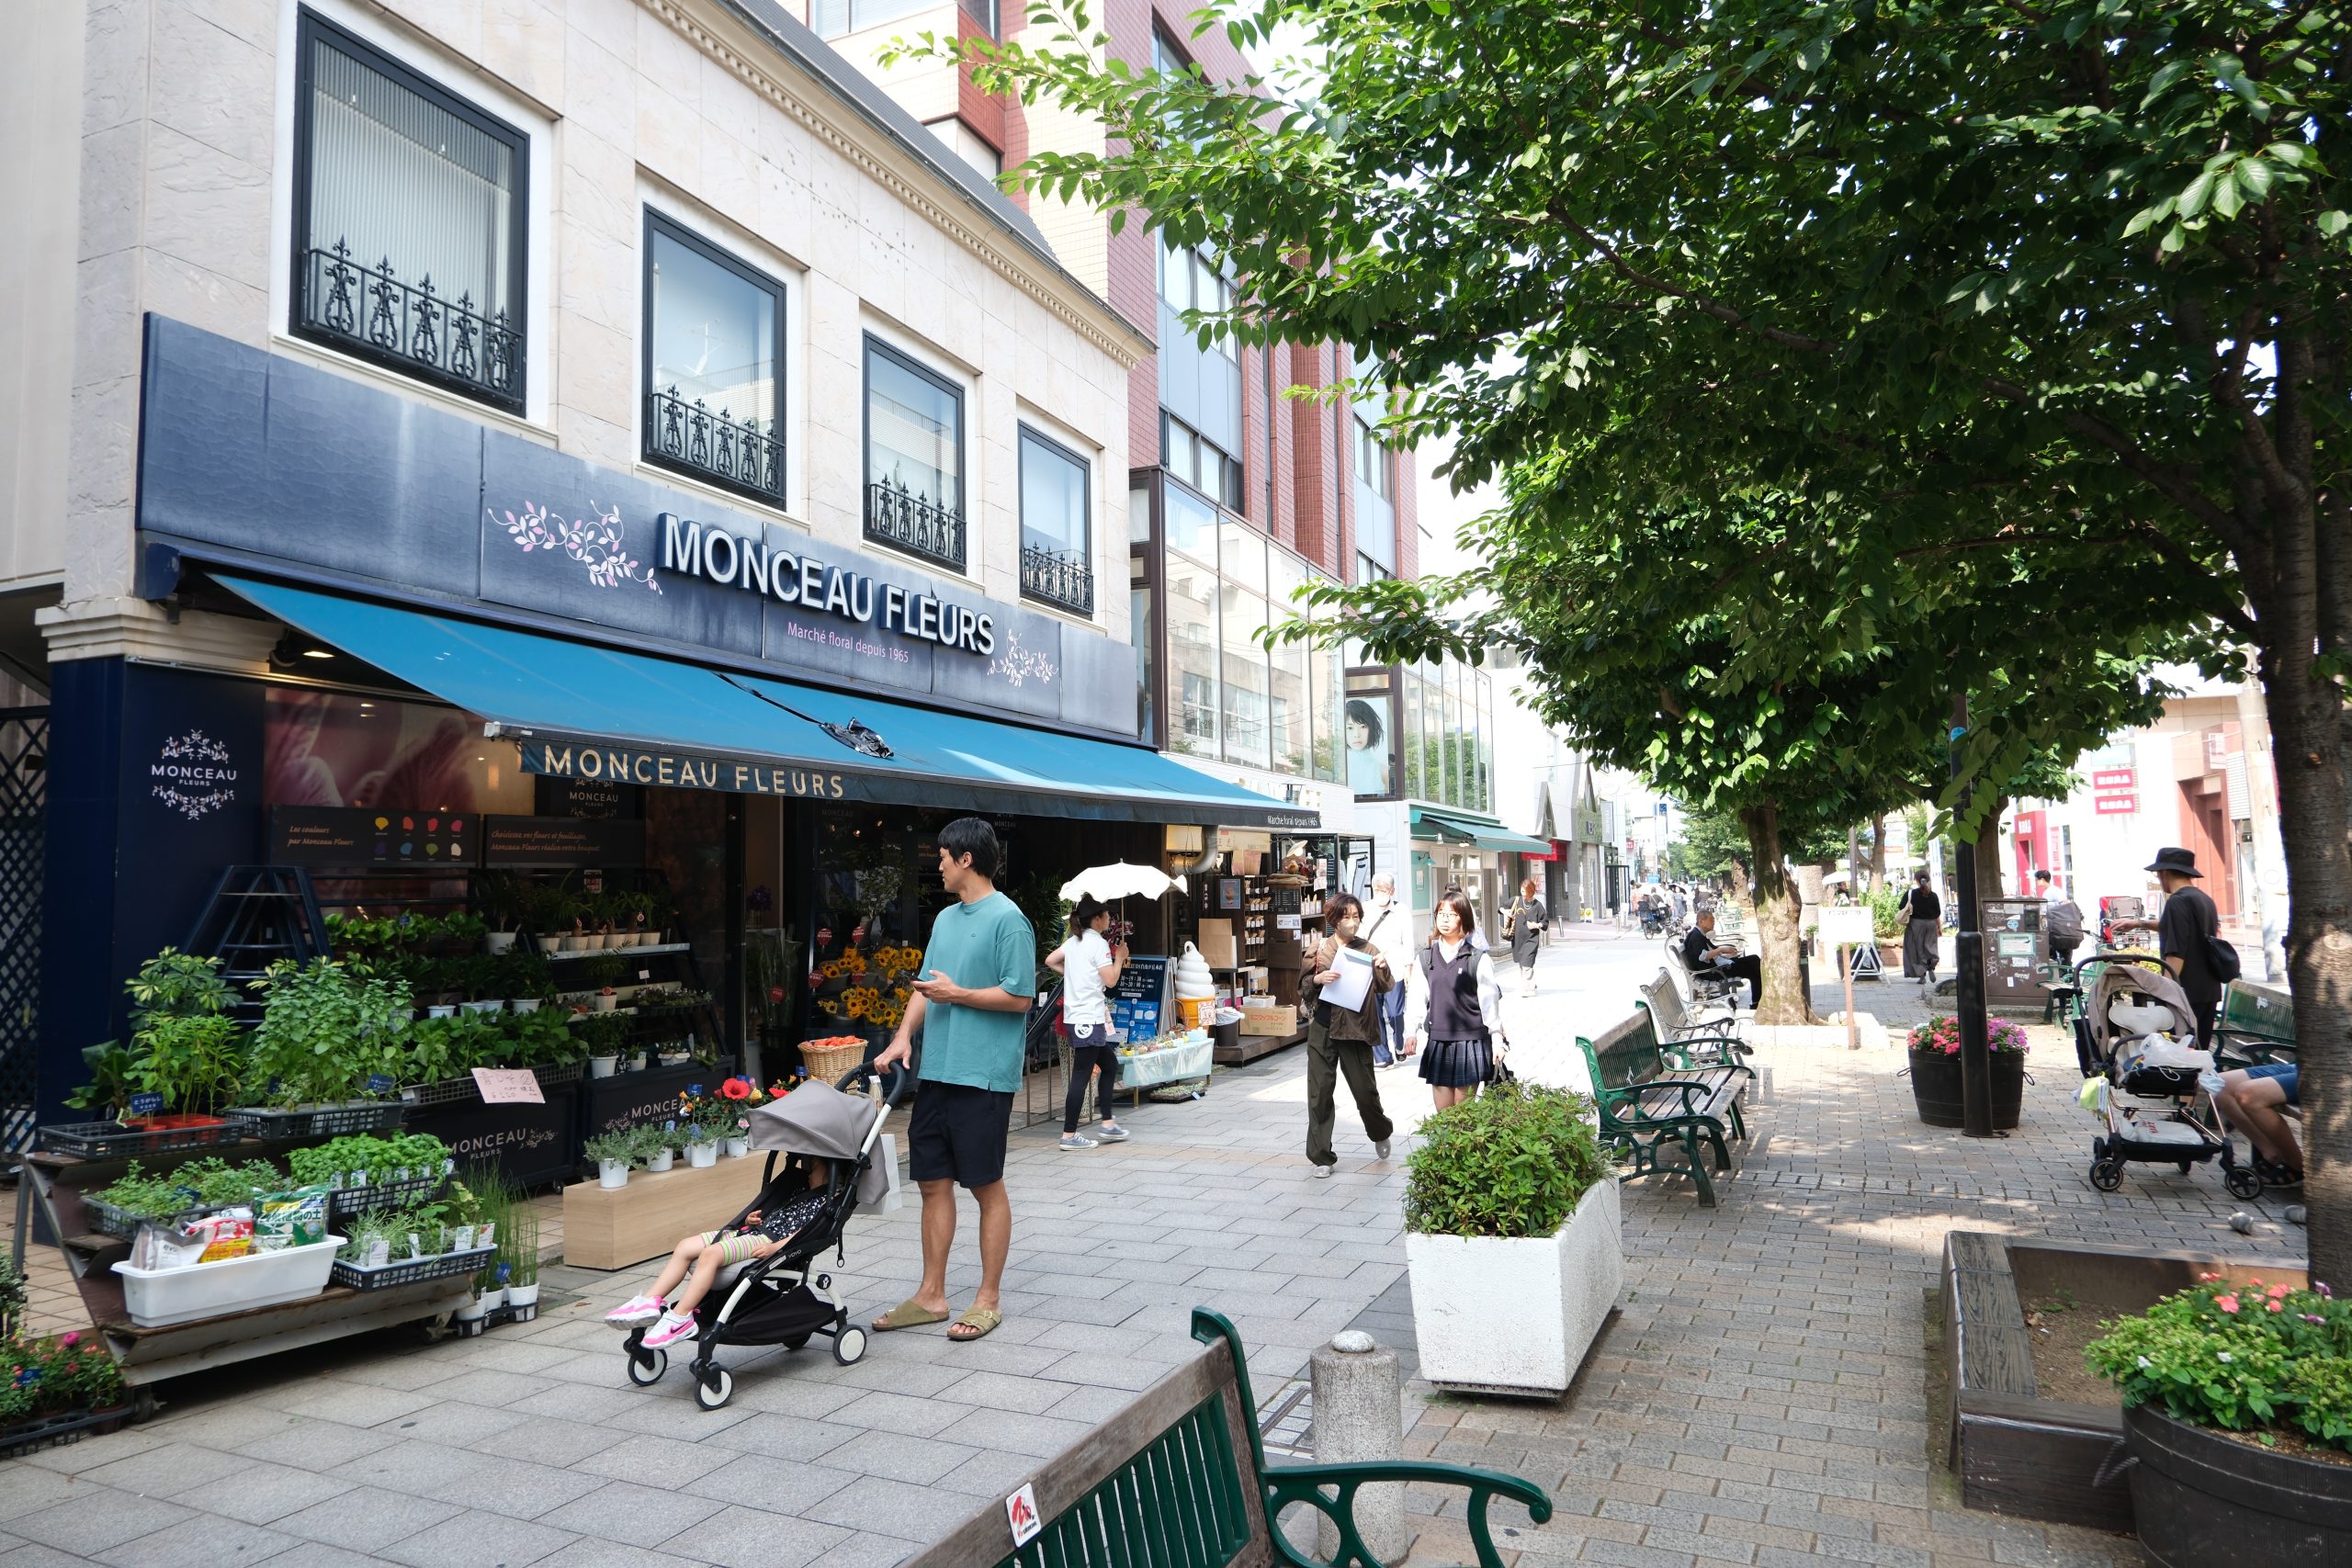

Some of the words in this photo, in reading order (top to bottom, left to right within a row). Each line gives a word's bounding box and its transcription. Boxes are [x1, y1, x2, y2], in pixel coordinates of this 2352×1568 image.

[658, 513, 874, 623] MONCEAU
[880, 582, 996, 656] FLEURS
[787, 621, 827, 644] Marché
[828, 630, 854, 651] floral
[855, 639, 887, 661] depuis
[888, 647, 910, 664] 1965
[151, 763, 238, 781] MONCEAU
[544, 744, 718, 788] MONCEAU
[735, 765, 844, 799] FLEURS
[569, 791, 619, 803] MONCEAU
[631, 1098, 692, 1119] MONCEA
[651, 1112, 675, 1122] FLEURS
[470, 1147, 501, 1159] FLEURS
[787, 1248, 802, 1259] YOYO
